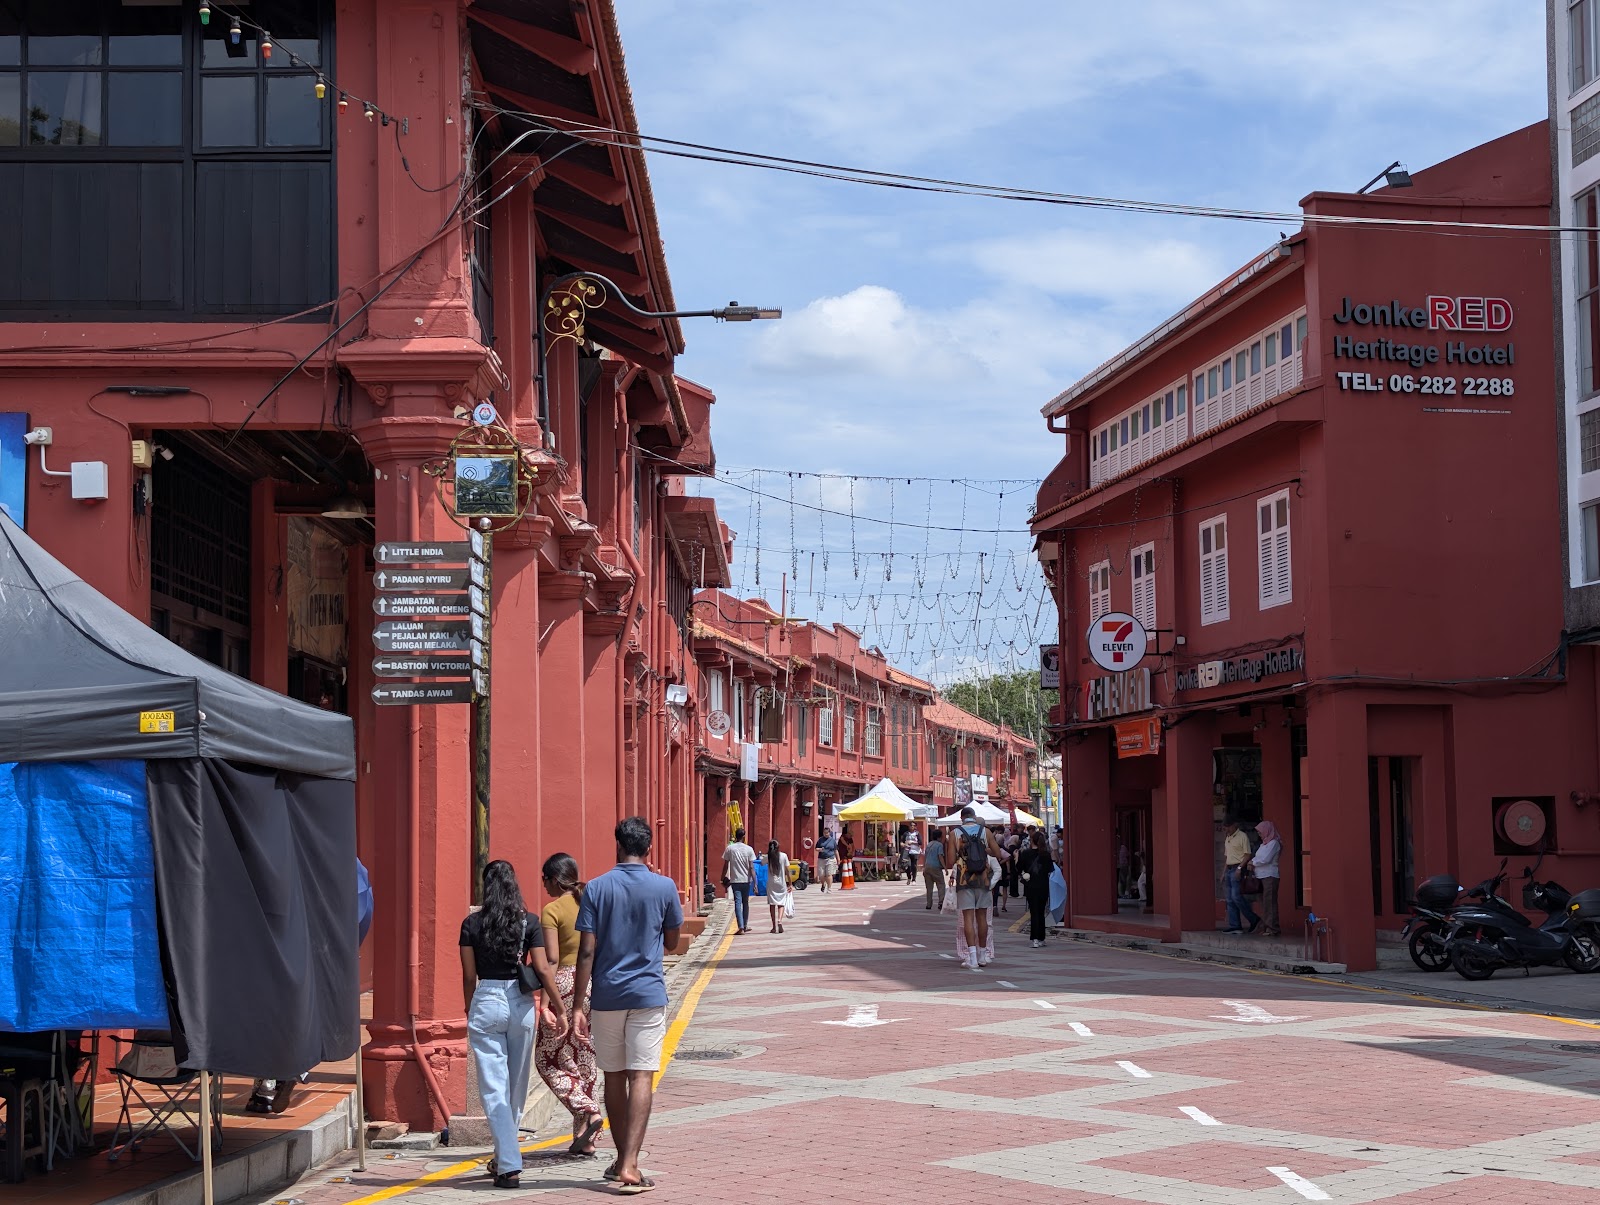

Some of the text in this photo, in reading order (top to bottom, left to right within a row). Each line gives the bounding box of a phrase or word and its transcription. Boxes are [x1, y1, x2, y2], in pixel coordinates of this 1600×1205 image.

[1335, 335, 1515, 367] Heritage Hotel
[1337, 371, 1515, 396] TEL: 06-282 2288
[391, 548, 444, 556] LITTLE INDIA
[391, 575, 452, 584] PADANG NYIRU
[391, 597, 435, 605] JAMBATAN
[309, 593, 327, 628] OPEN
[391, 605, 470, 614] CHAN KOON CHENG
[391, 622, 424, 630] LALUAN
[391, 632, 450, 640] PEJALAN KAKI
[391, 641, 458, 649] SUNGAI MELAKA
[390, 662, 471, 670] BASTION VICTORIA
[1222, 659, 1262, 683] Heritage
[1264, 649, 1292, 676] Hotel
[390, 689, 453, 698] TANDAS AWAM
